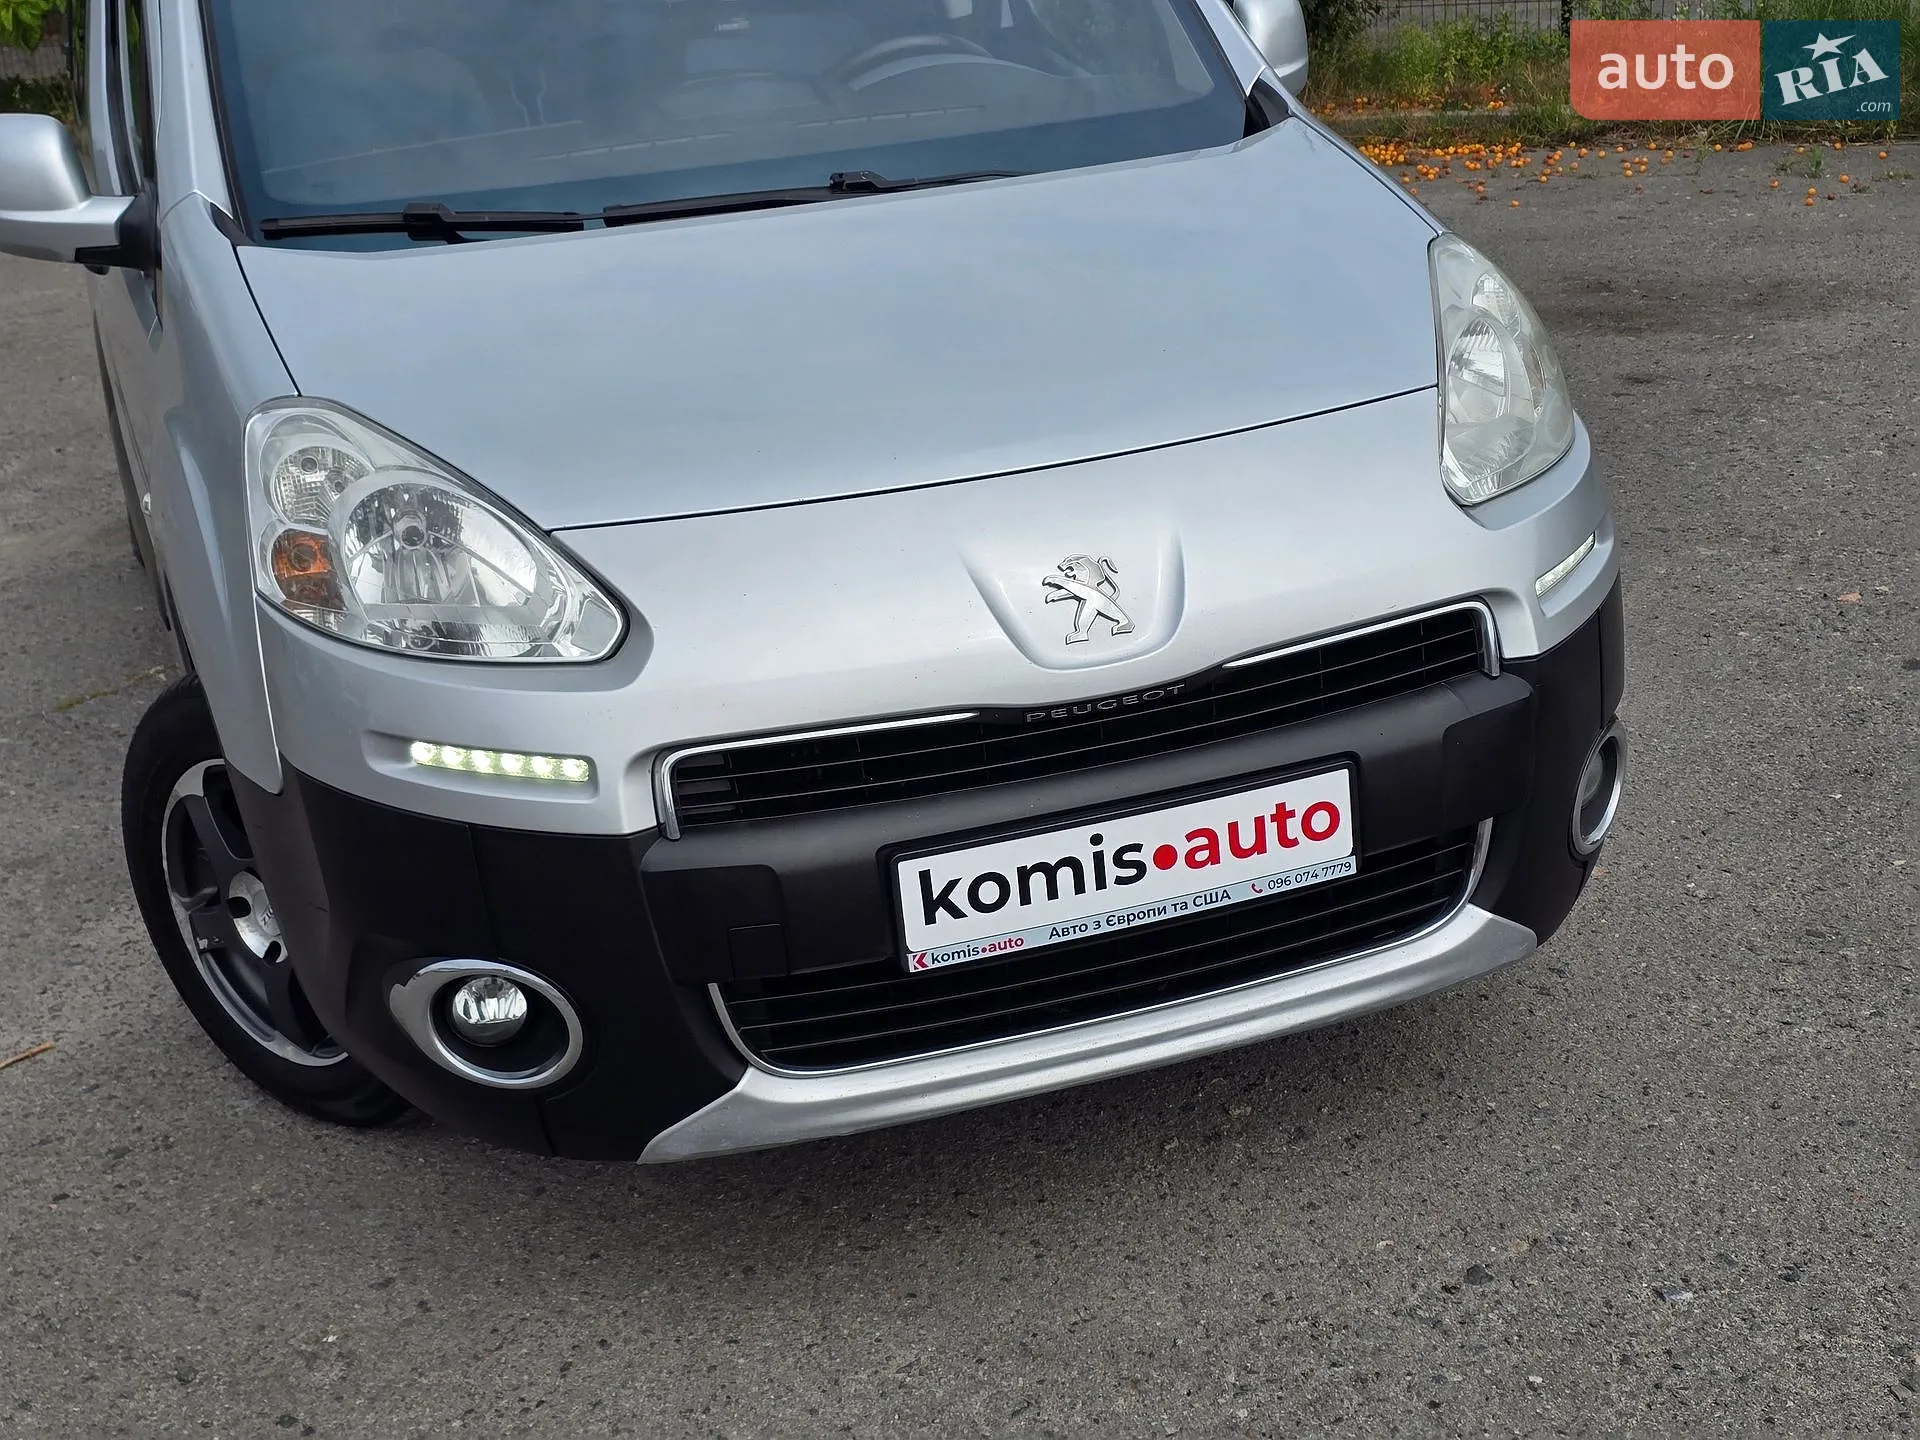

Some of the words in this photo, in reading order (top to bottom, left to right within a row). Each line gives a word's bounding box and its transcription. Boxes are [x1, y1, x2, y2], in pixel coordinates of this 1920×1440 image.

[1026, 684, 1185, 722] PEUGEOT
[1267, 874, 1292, 890] 096
[1294, 869, 1320, 884] 074
[1321, 861, 1352, 877] 7779
[1048, 921, 1089, 940] Авто
[1092, 919, 1102, 931] з
[1105, 904, 1167, 927] Європи
[1171, 900, 1188, 913] та
[1192, 889, 1232, 908] США
